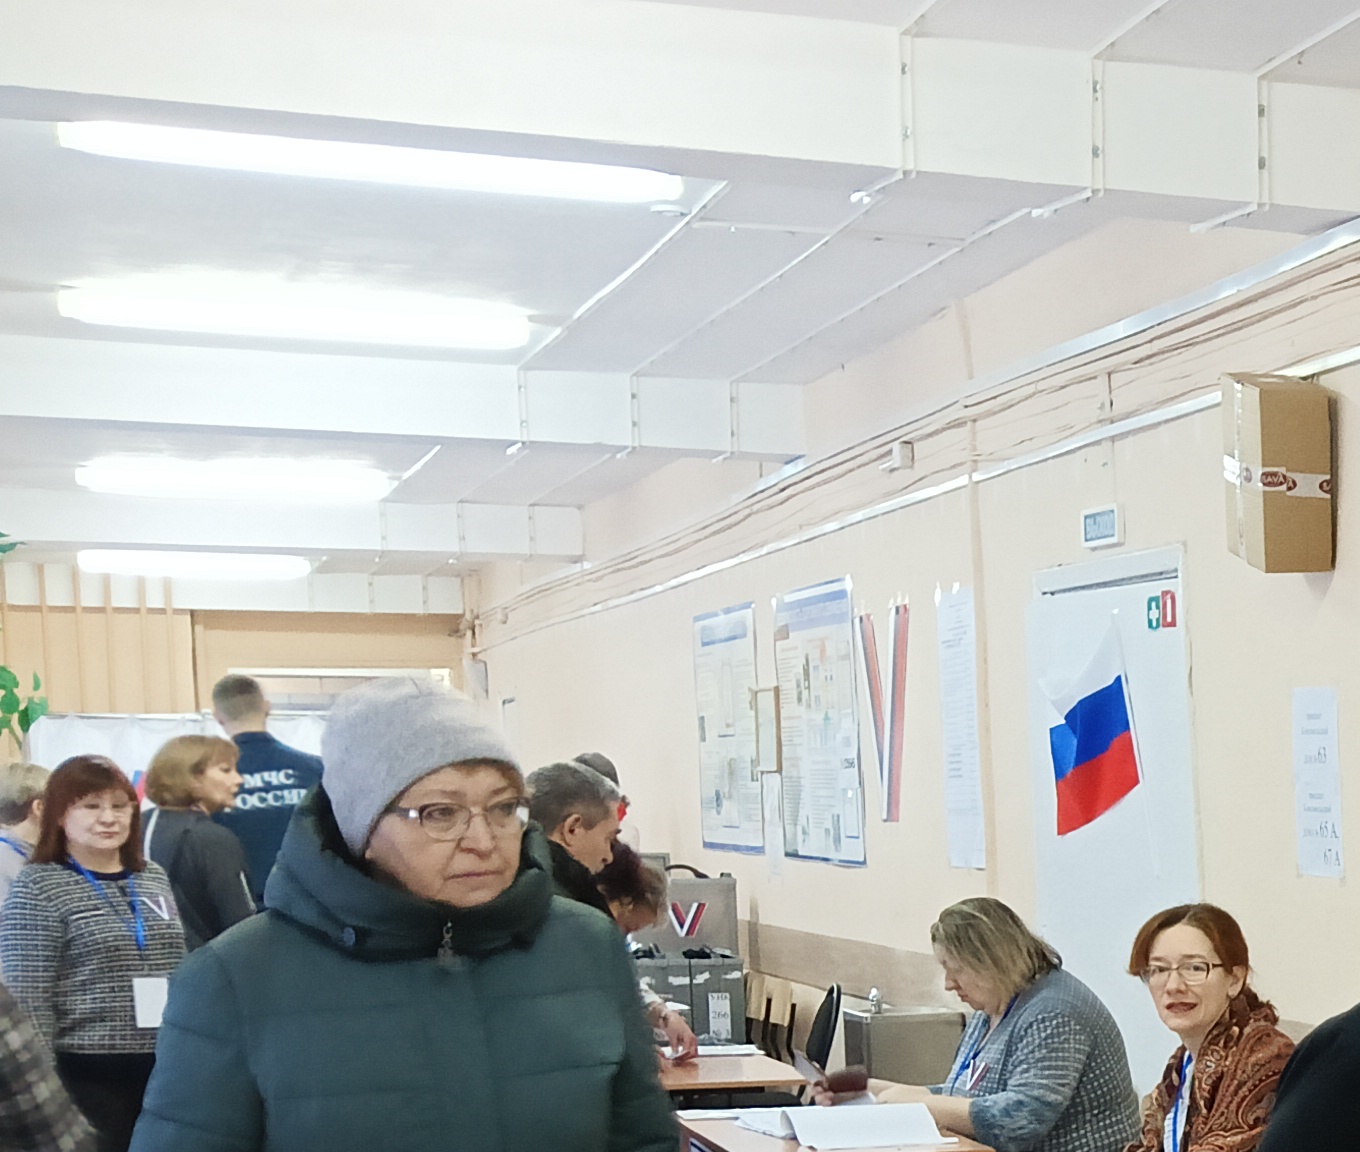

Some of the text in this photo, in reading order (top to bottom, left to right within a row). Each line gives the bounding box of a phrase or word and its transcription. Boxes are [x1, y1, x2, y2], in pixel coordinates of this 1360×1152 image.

[1318, 746, 1327, 765] 63
[243, 769, 295, 789] МЧС
[224, 788, 307, 812] ОССИ
[1319, 820, 1329, 838] 65
